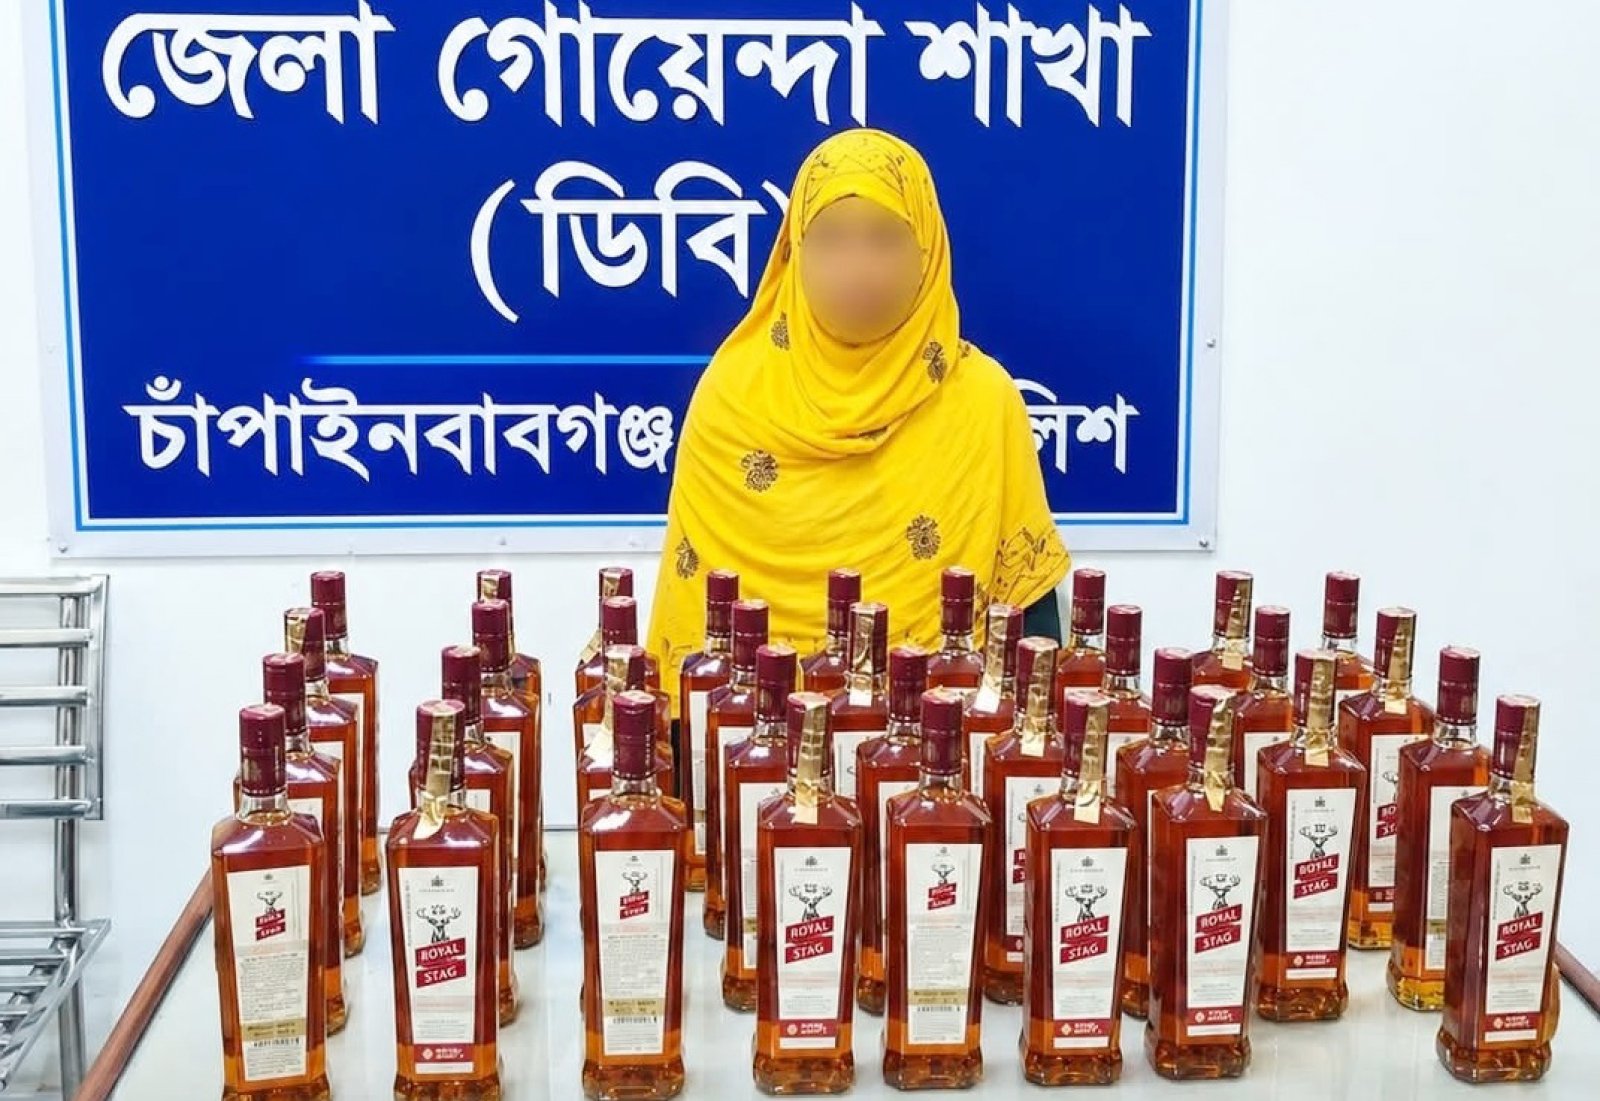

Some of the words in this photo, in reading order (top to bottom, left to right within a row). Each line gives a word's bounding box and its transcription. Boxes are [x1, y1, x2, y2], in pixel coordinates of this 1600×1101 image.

[103, 1, 396, 124] জেলা
[438, 1, 885, 127] গোয়েন্দা
[904, 2, 1152, 127] শাখা
[123, 376, 675, 482] চাঁপাইনবাবগঞ্জ
[791, 921, 829, 939] ROYAL
[421, 943, 460, 961] ROYAL
[793, 943, 824, 960] STAG
[1503, 938, 1533, 956] STAG
[424, 965, 457, 983] STAG
